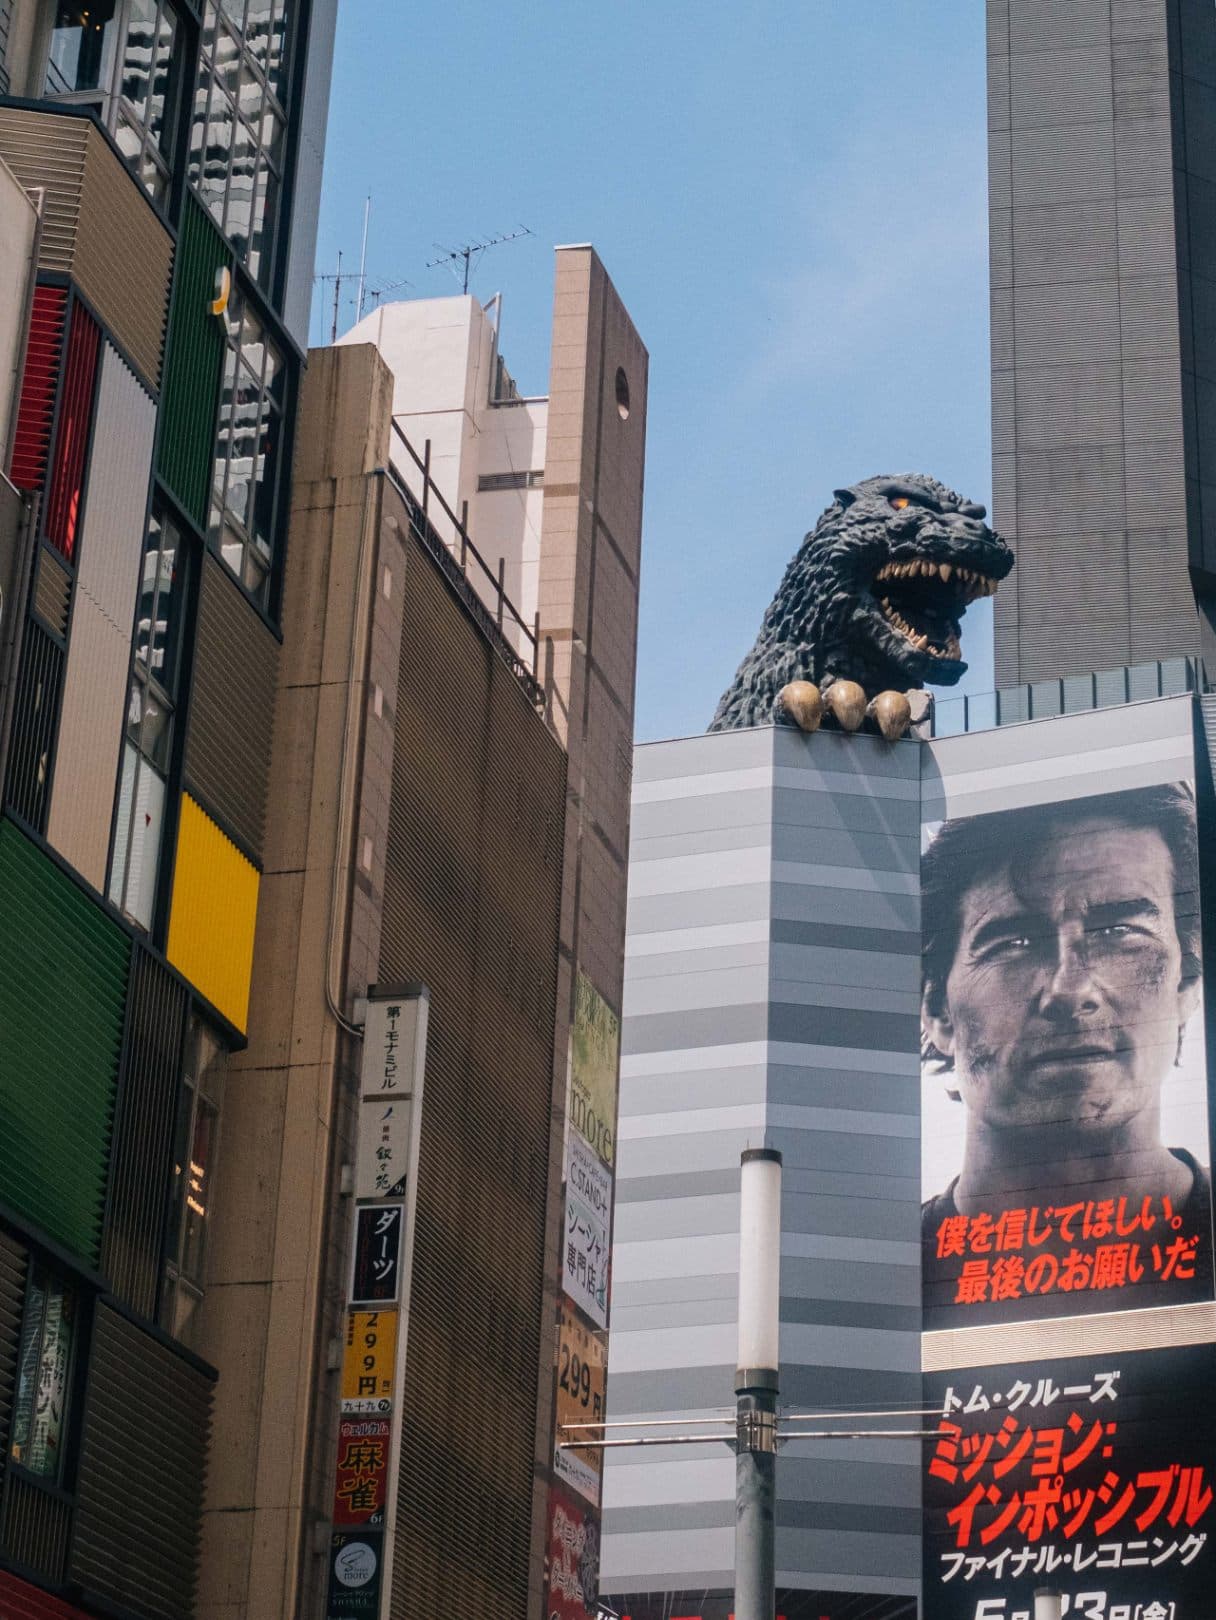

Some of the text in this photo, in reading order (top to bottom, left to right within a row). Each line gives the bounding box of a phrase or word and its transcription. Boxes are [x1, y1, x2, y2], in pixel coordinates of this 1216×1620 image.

[374, 1210, 399, 1280] ダーツ
[935, 1195, 1183, 1259] 僕を信じてほしい。
[954, 1235, 1200, 1305] 最後のお願いだ
[358, 1312, 378, 1396] 299円
[342, 1422, 389, 1437] ウェルカム
[941, 1371, 1120, 1418] トム・クルーズ
[338, 1439, 384, 1513] 麻雀
[946, 1464, 1213, 1548] インポッシブル
[941, 1533, 1207, 1583] ファイナル・レコニング
